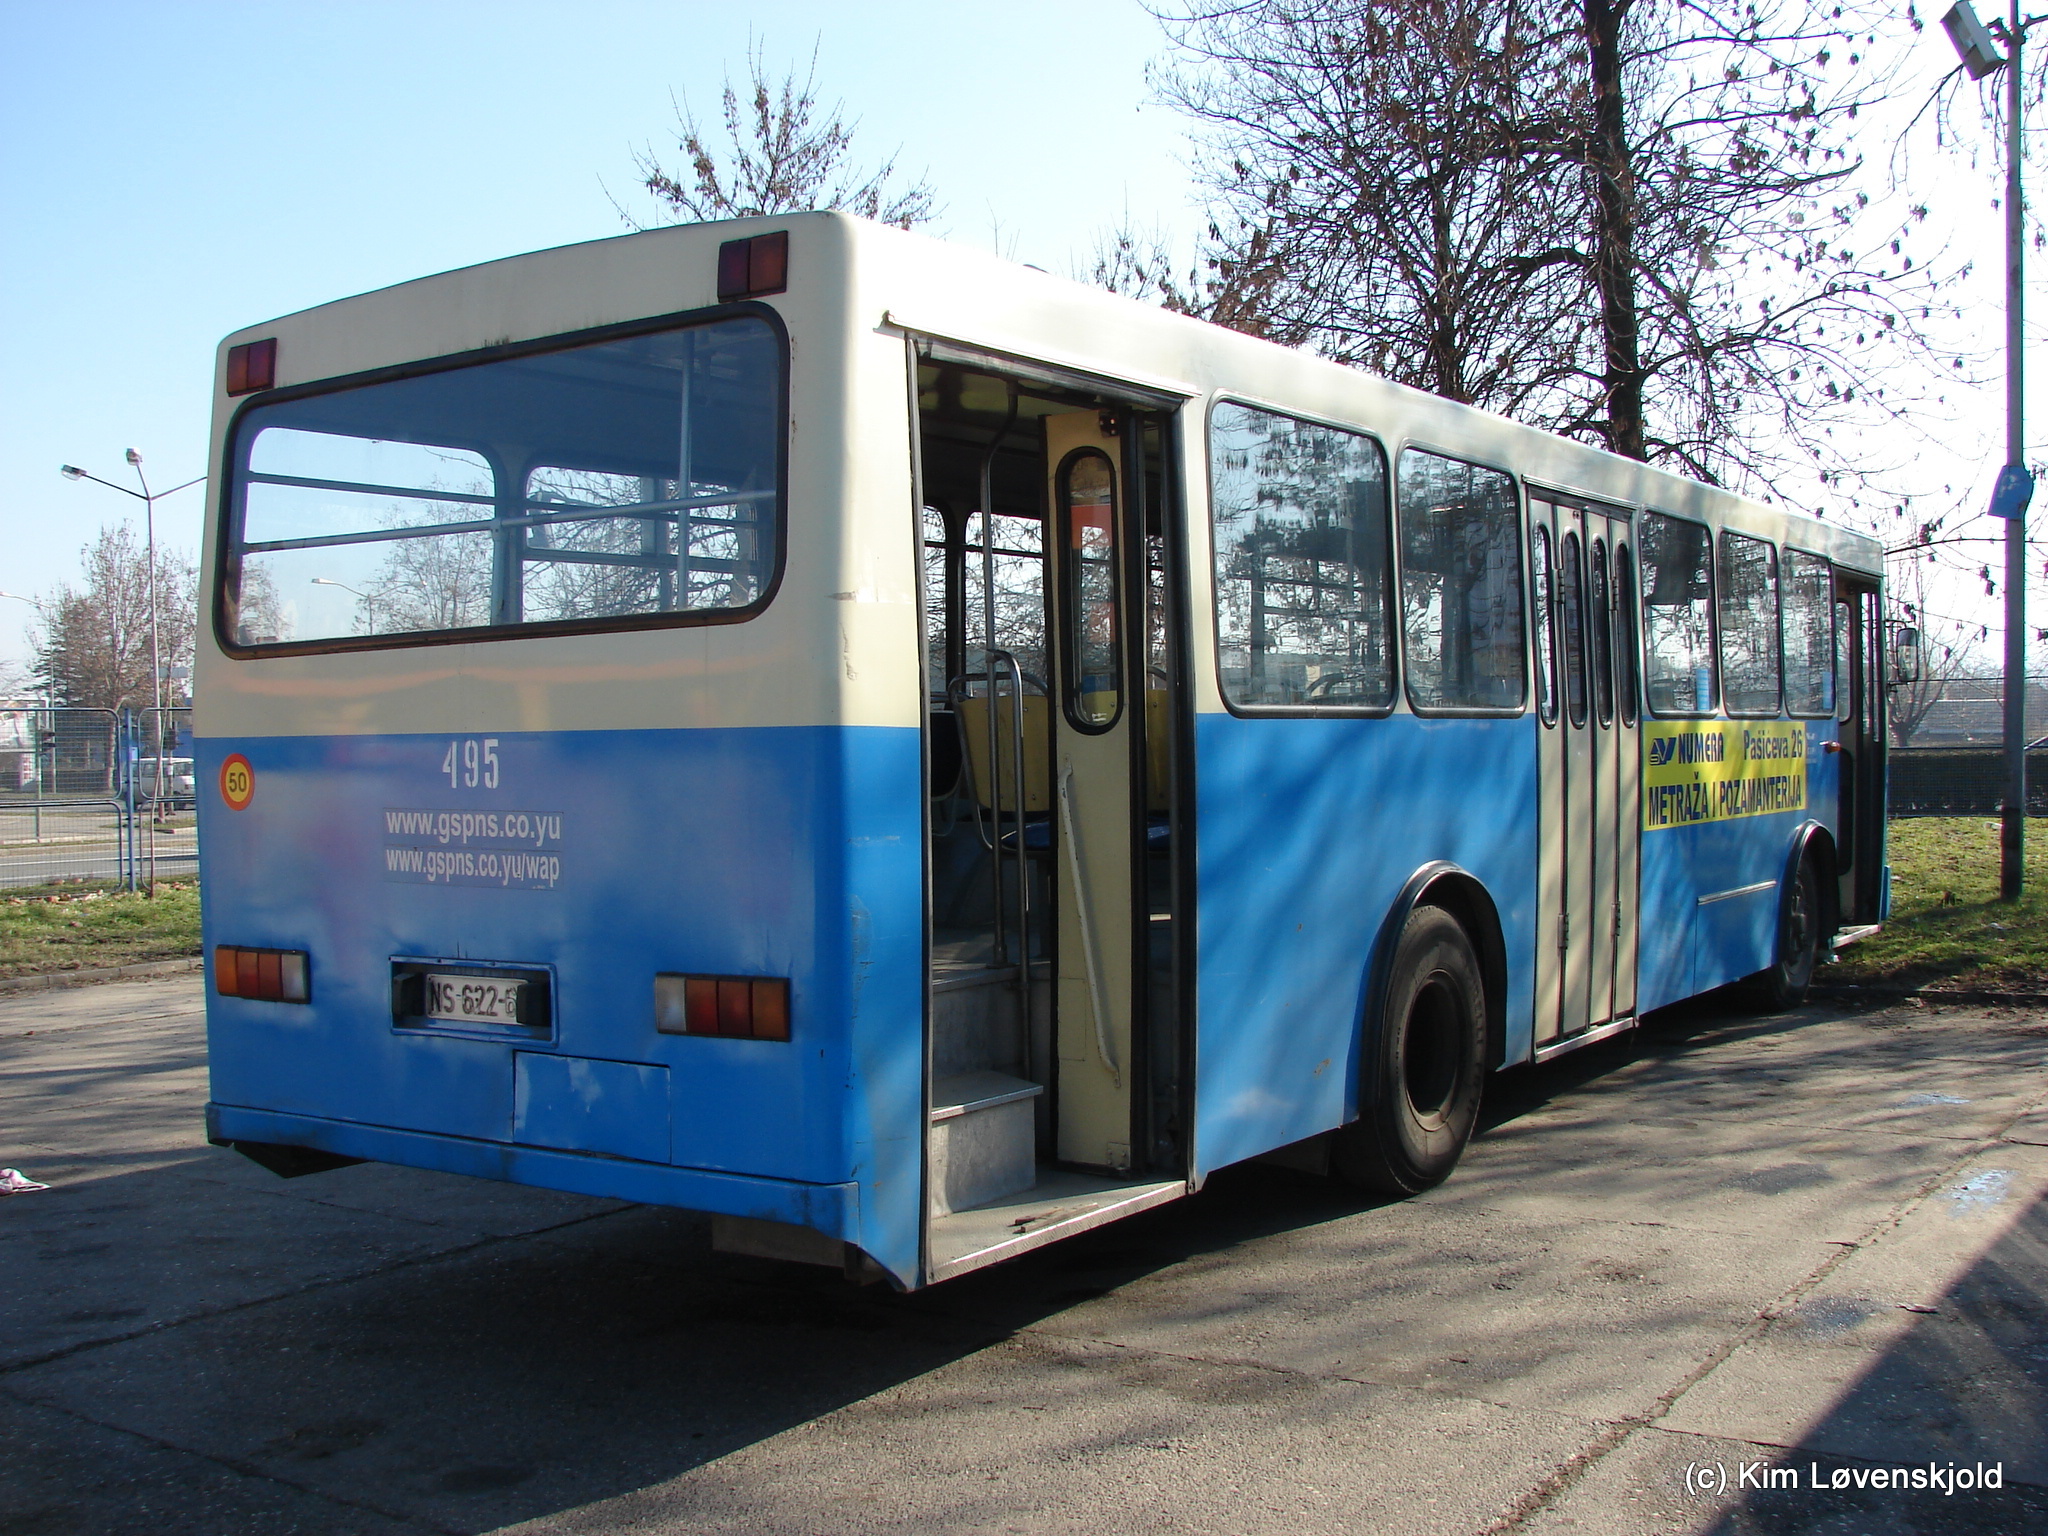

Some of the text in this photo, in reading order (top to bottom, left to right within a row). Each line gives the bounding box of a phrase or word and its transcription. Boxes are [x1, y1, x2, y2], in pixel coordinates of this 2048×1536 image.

[1791, 729, 1803, 759] 26
[442, 738, 499, 789] 495
[228, 772, 248, 793] 50
[1648, 771, 1709, 827] METRAŽA
[1719, 774, 1802, 817] POZAMANTERIJA
[386, 811, 561, 847] www.gspns.co.yu
[386, 849, 560, 887] www.gspns.co.yu/wap
